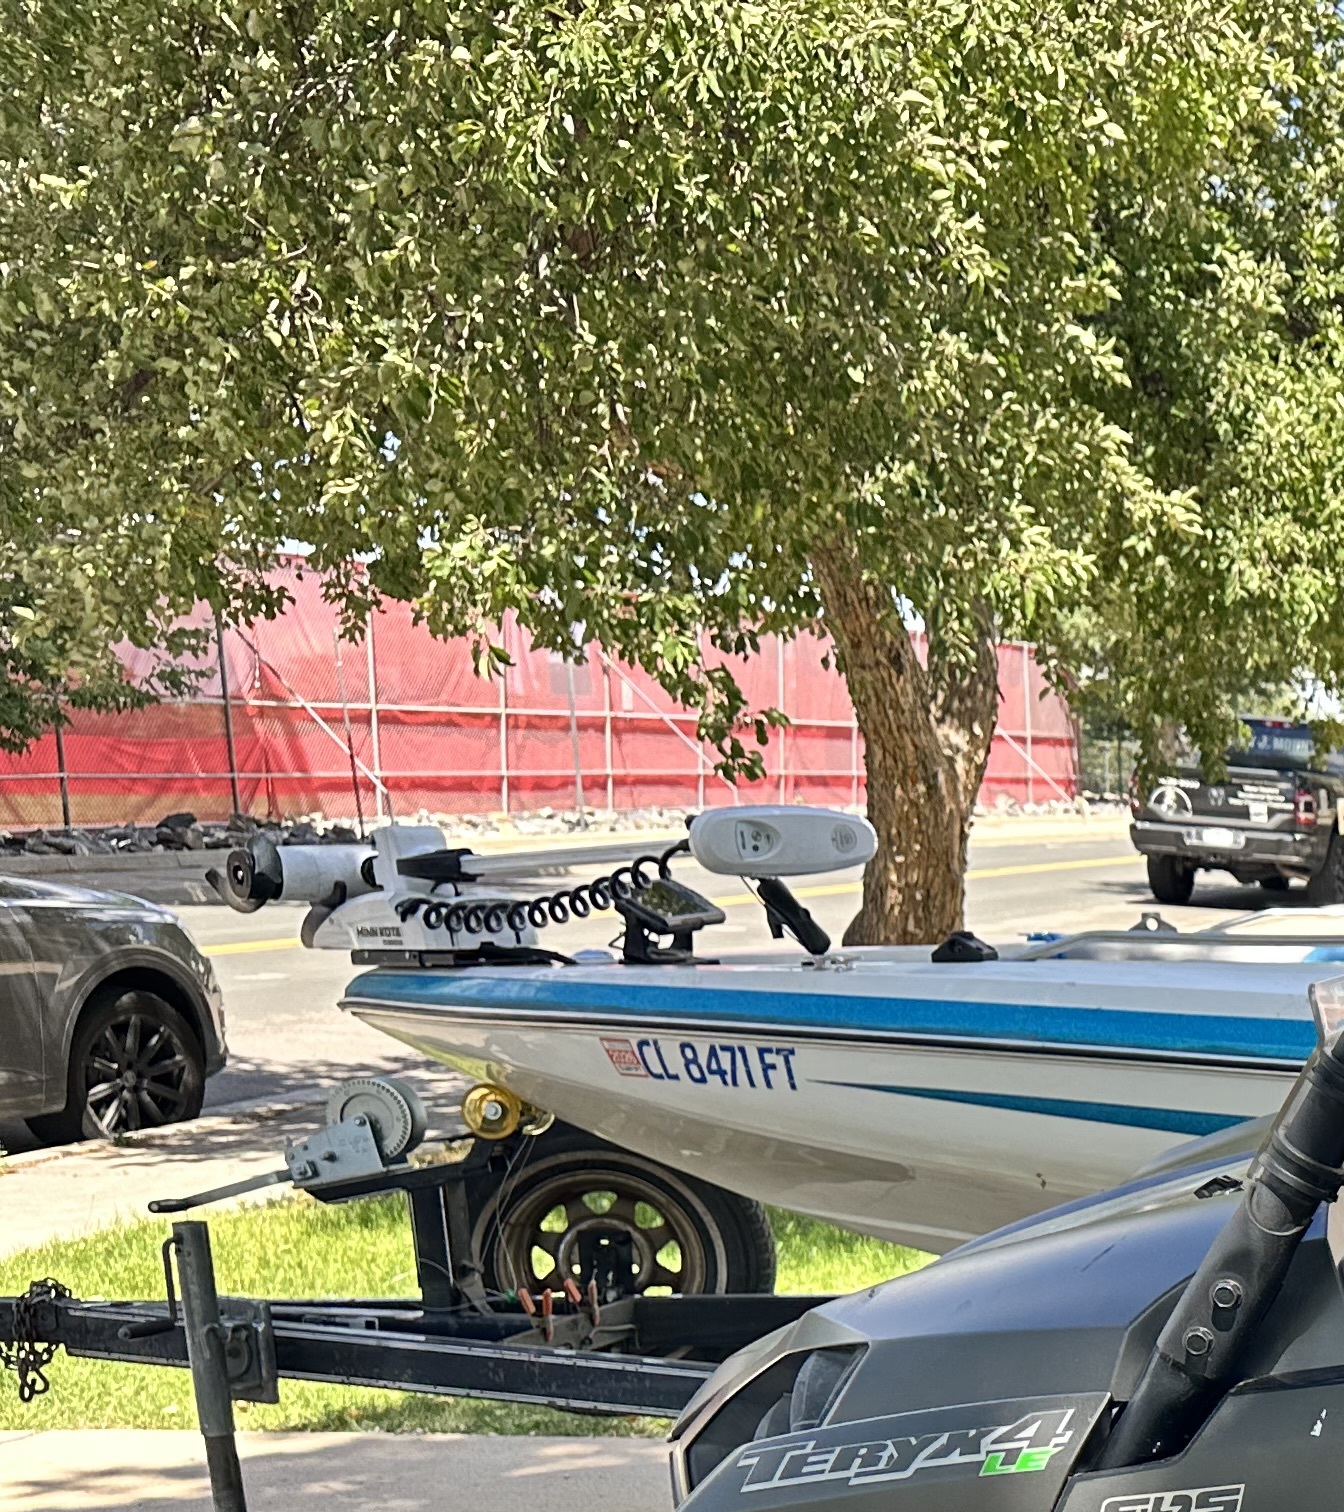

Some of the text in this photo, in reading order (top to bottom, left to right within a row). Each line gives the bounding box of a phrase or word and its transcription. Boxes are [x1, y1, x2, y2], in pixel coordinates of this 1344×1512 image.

[636, 1038, 798, 1091] CL 8471 FT
[737, 1408, 1075, 1494] TERYX4
[978, 1446, 1065, 1478] LE
